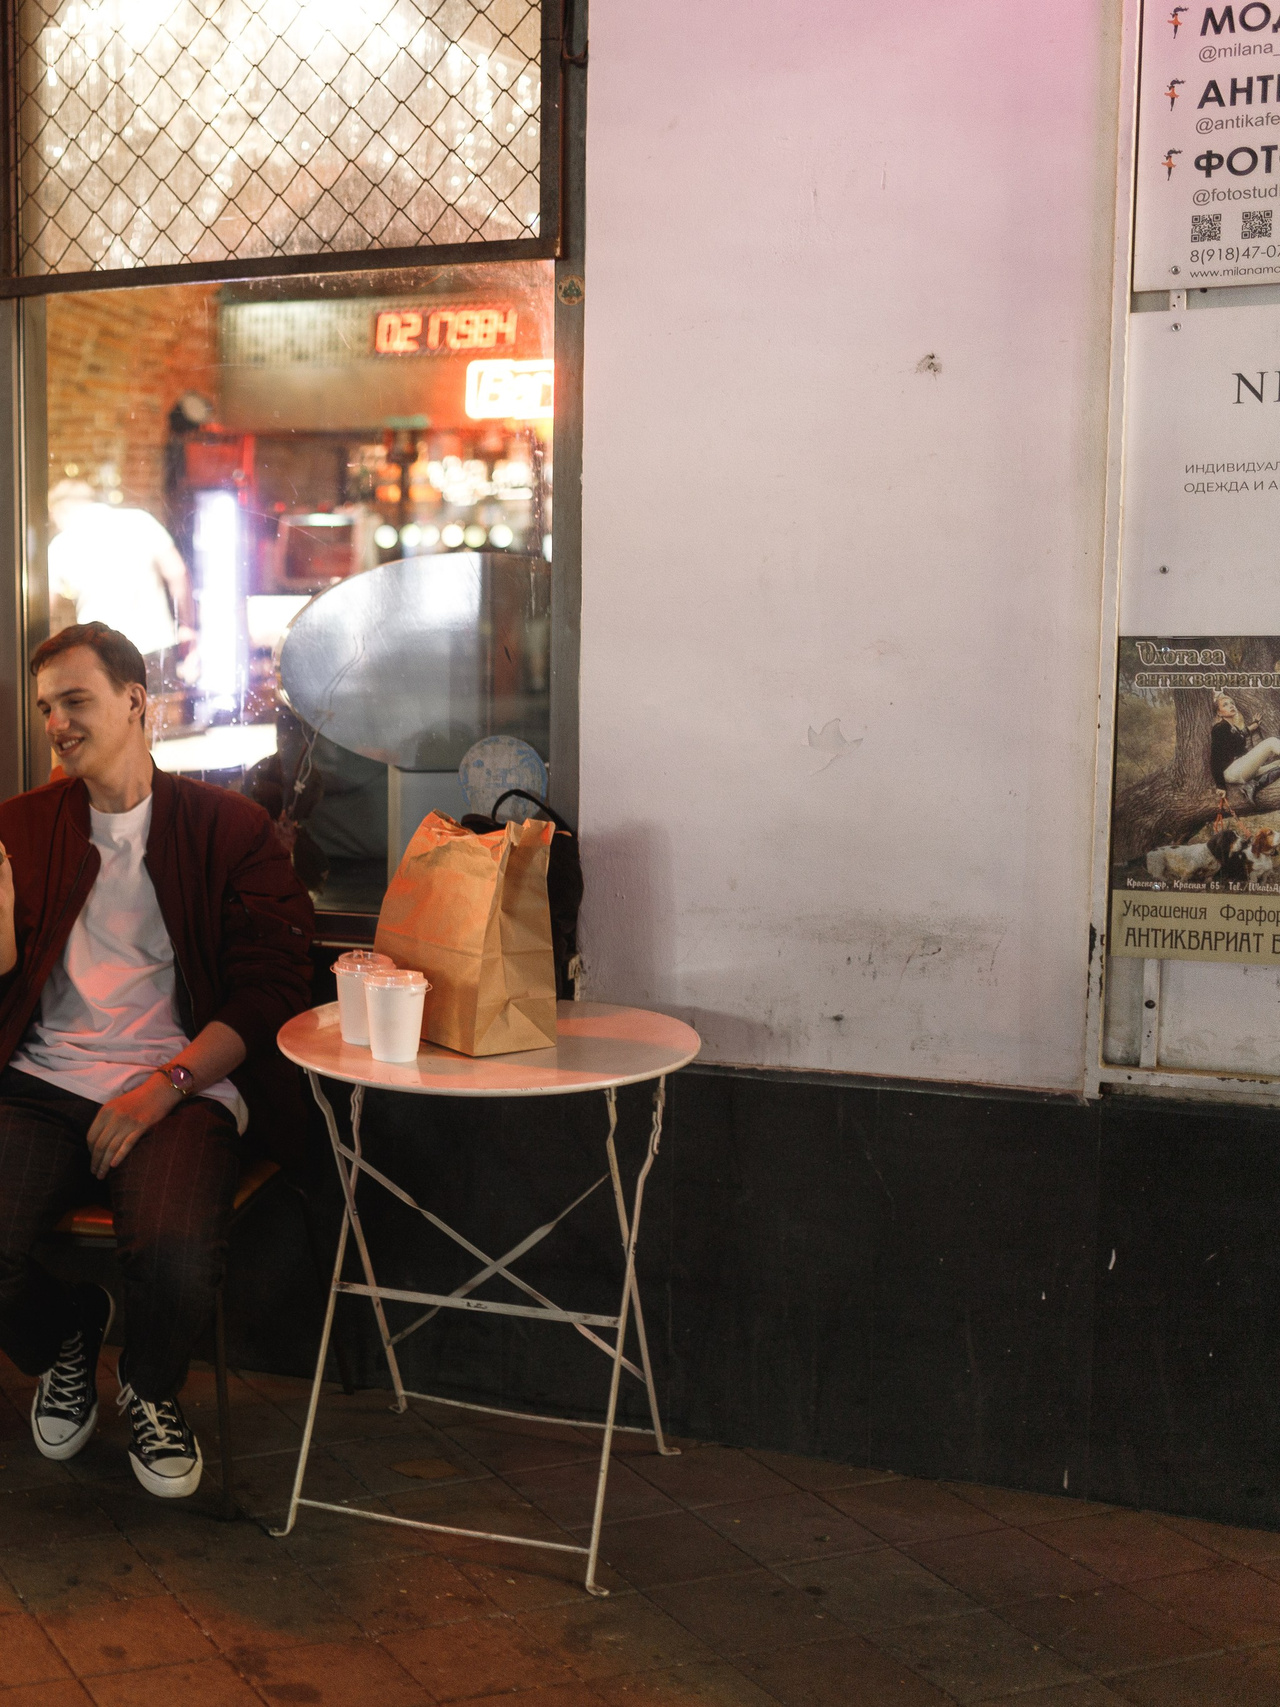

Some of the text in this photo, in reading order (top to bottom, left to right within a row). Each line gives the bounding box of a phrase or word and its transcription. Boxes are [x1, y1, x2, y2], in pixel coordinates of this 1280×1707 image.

[1197, 74, 1280, 110] АНТ
[1195, 112, 1280, 135] @antikafe
[1194, 145, 1280, 178] ФОТ
[1192, 184, 1280, 206] @fotostud
[1232, 371, 1280, 405] N
[1184, 481, 1250, 494] ОДЕЖДА
[1254, 480, 1264, 490] И
[1200, 650, 1225, 666] за
[1122, 900, 1207, 921] Украшения
[1124, 927, 1264, 953] АНТИКВАРИАТ
